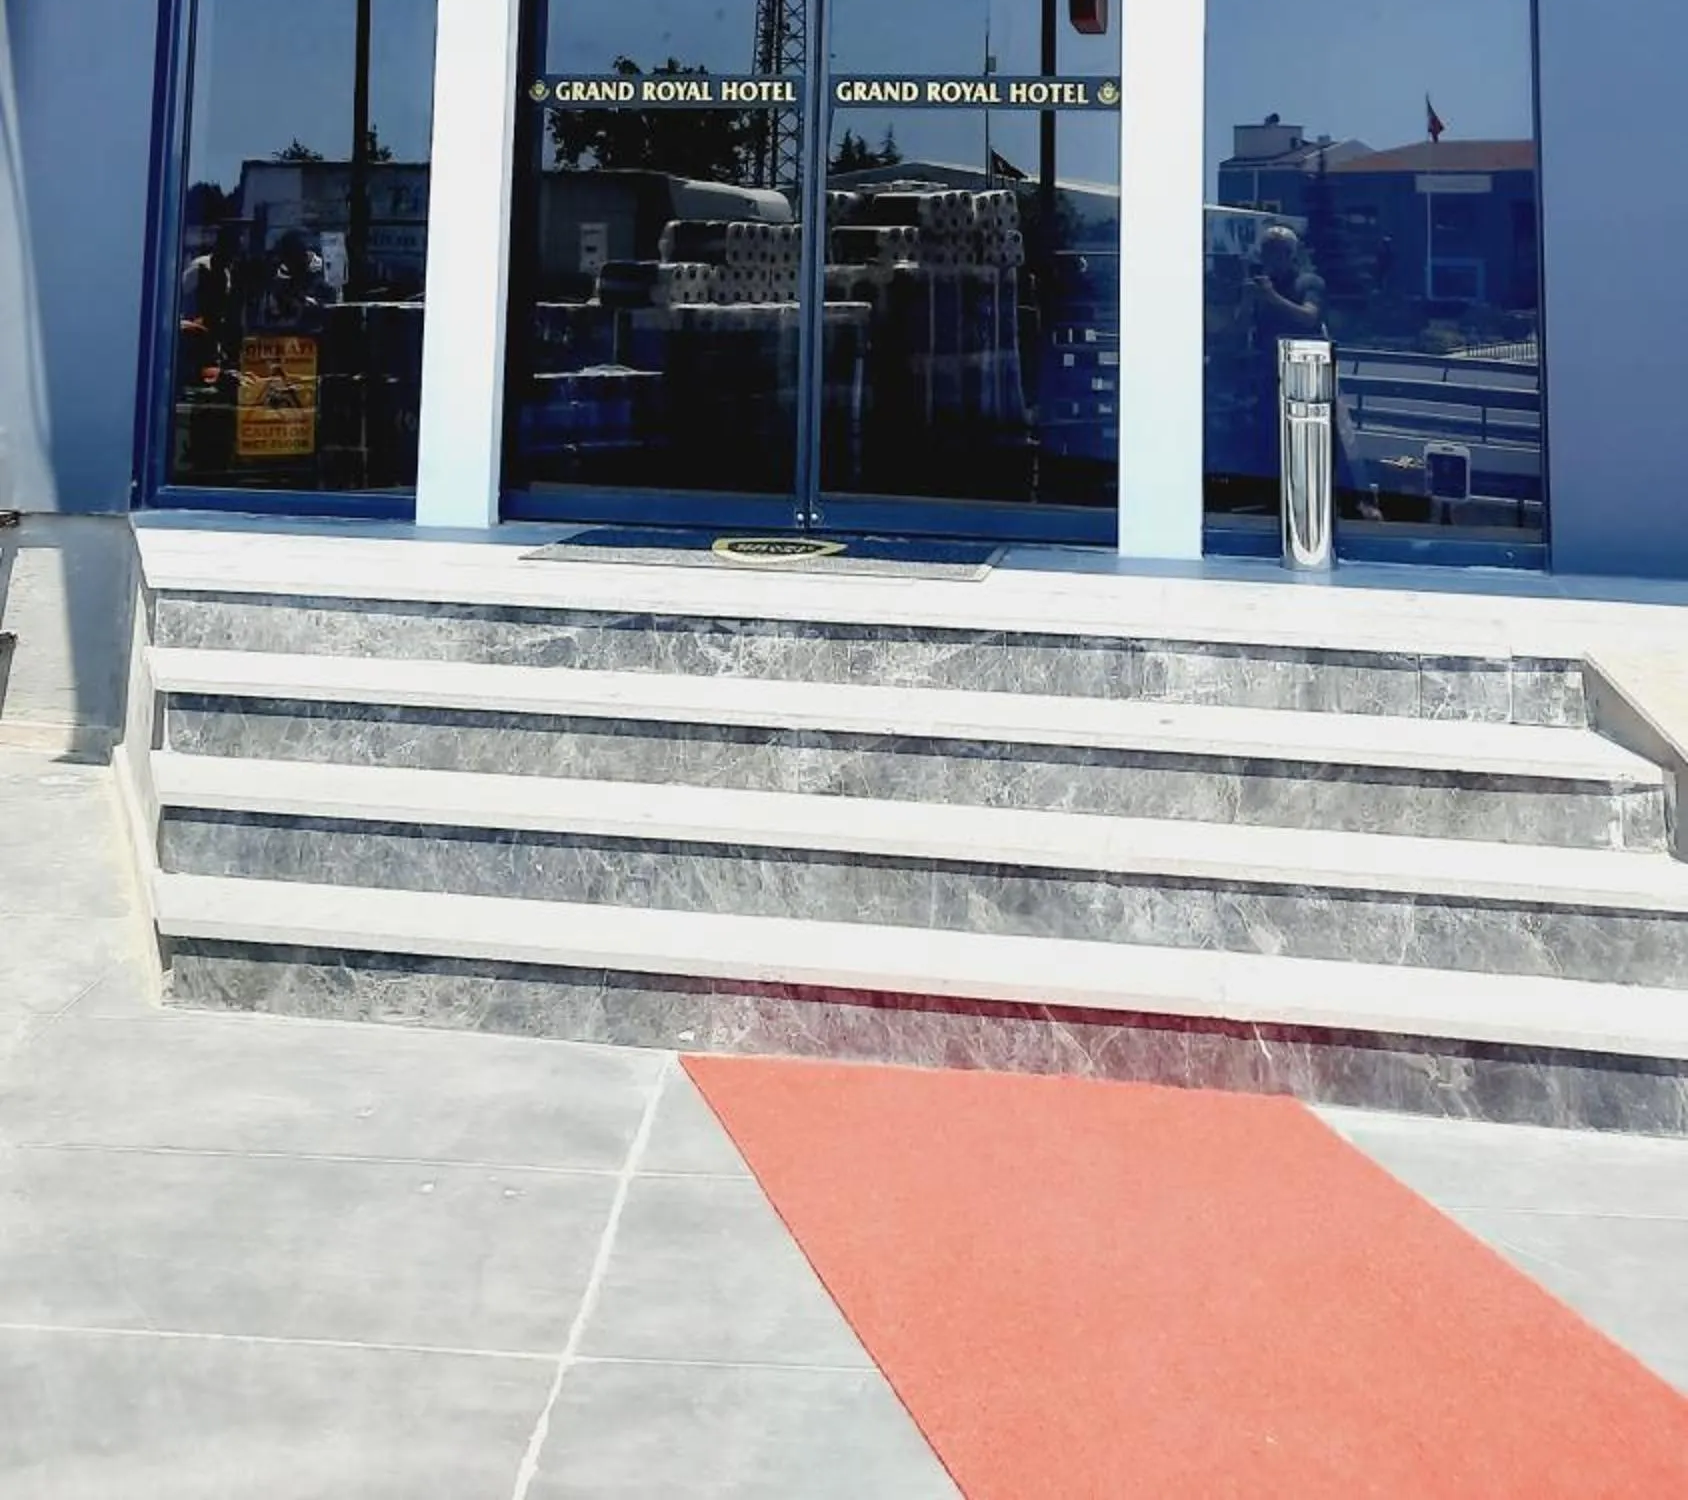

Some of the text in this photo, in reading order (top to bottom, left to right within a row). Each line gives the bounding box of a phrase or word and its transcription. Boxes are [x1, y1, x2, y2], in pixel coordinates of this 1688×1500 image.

[555, 80, 797, 101] GRAND ROYAL HOTEL
[836, 81, 1089, 104] GRAND ROYAL HOTEL
